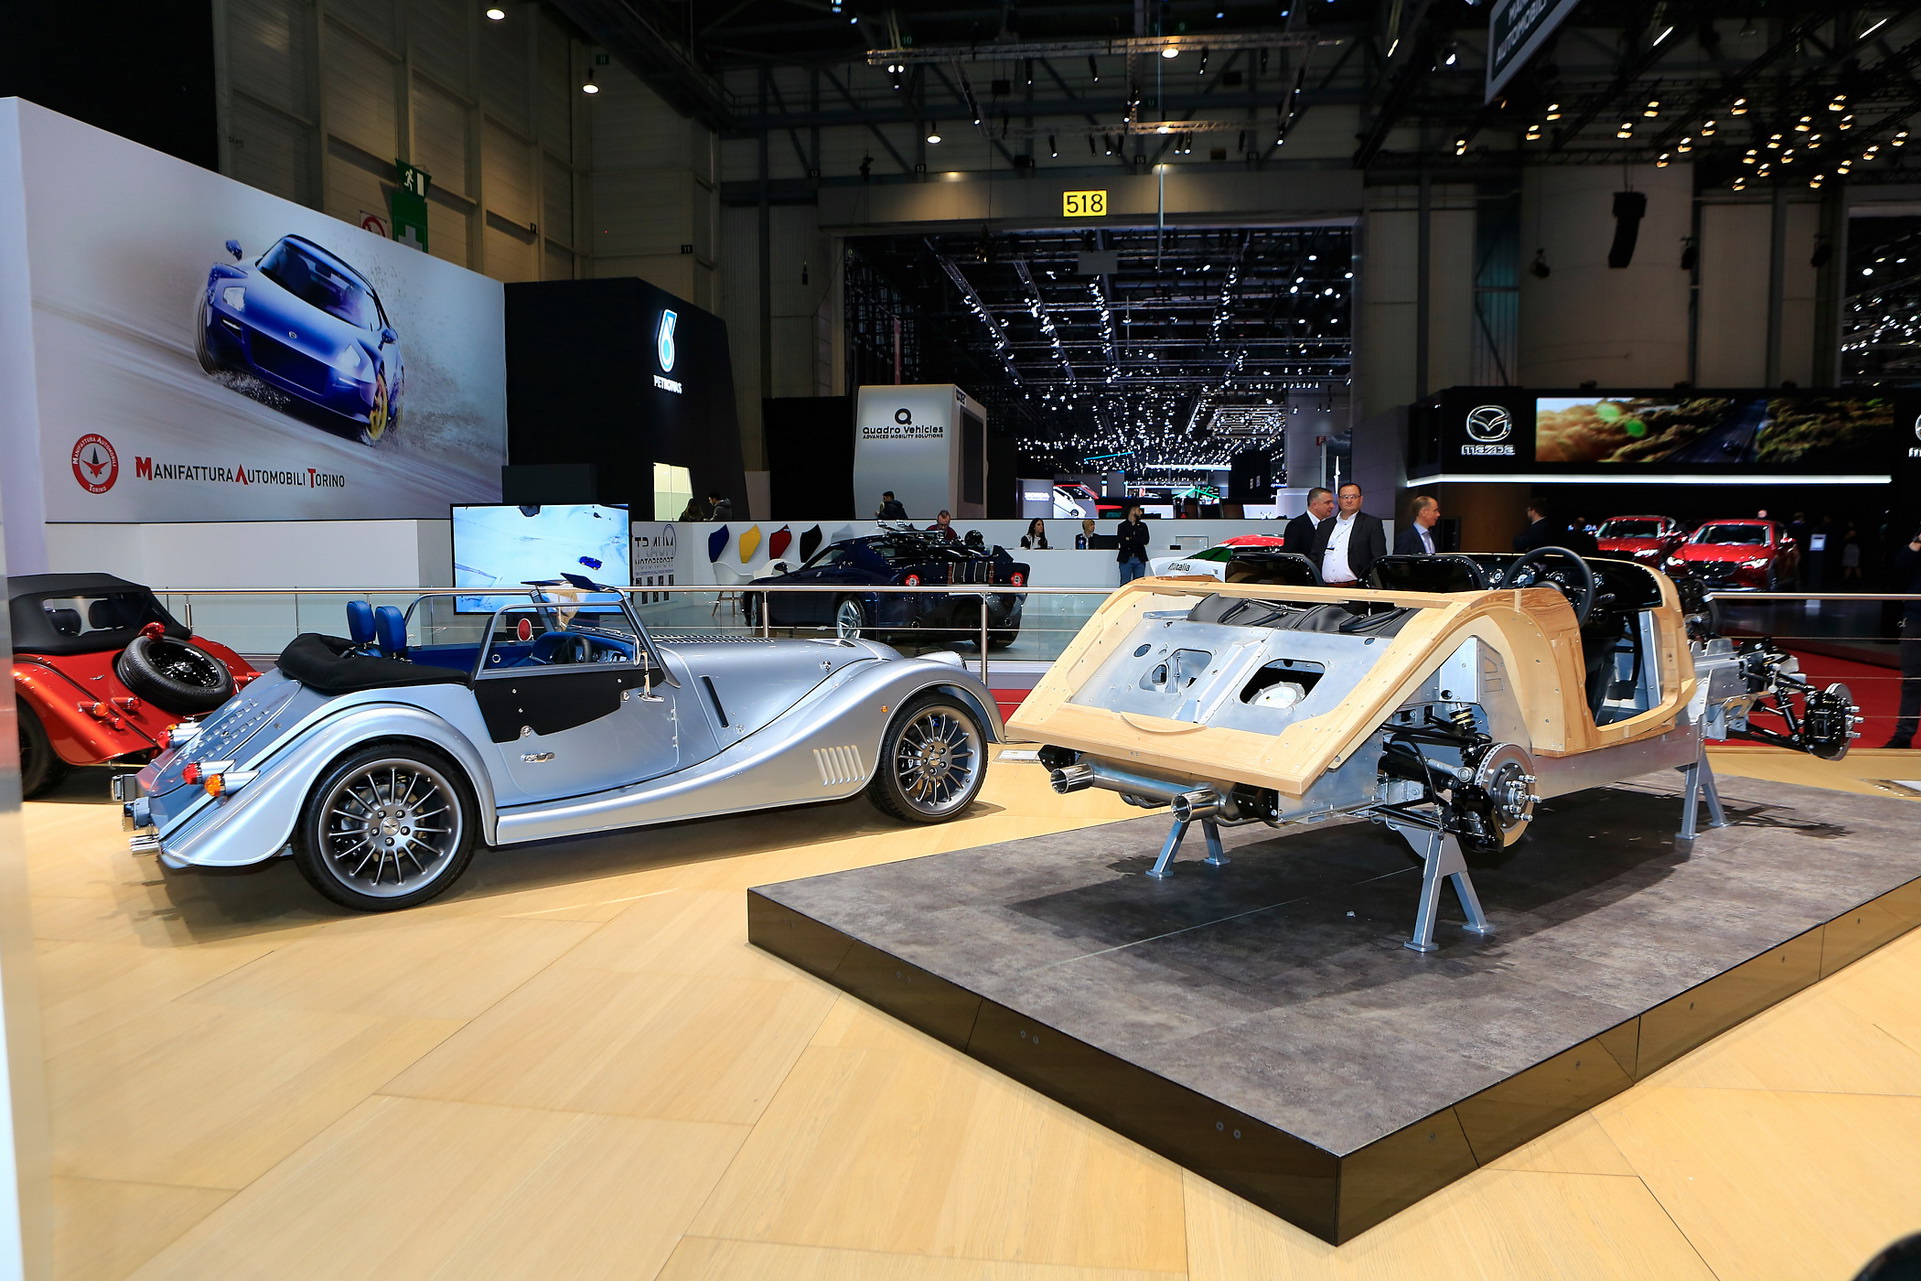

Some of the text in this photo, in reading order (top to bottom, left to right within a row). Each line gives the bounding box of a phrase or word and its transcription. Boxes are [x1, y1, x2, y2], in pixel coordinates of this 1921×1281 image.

[1067, 194, 1103, 213] 518
[653, 375, 682, 394] PETRONAS
[862, 425, 944, 434] Quadro Vehicles
[134, 456, 345, 488] MANIFATTURA AUTOMOBILI TORINO
[88, 484, 107, 493] TORINO
